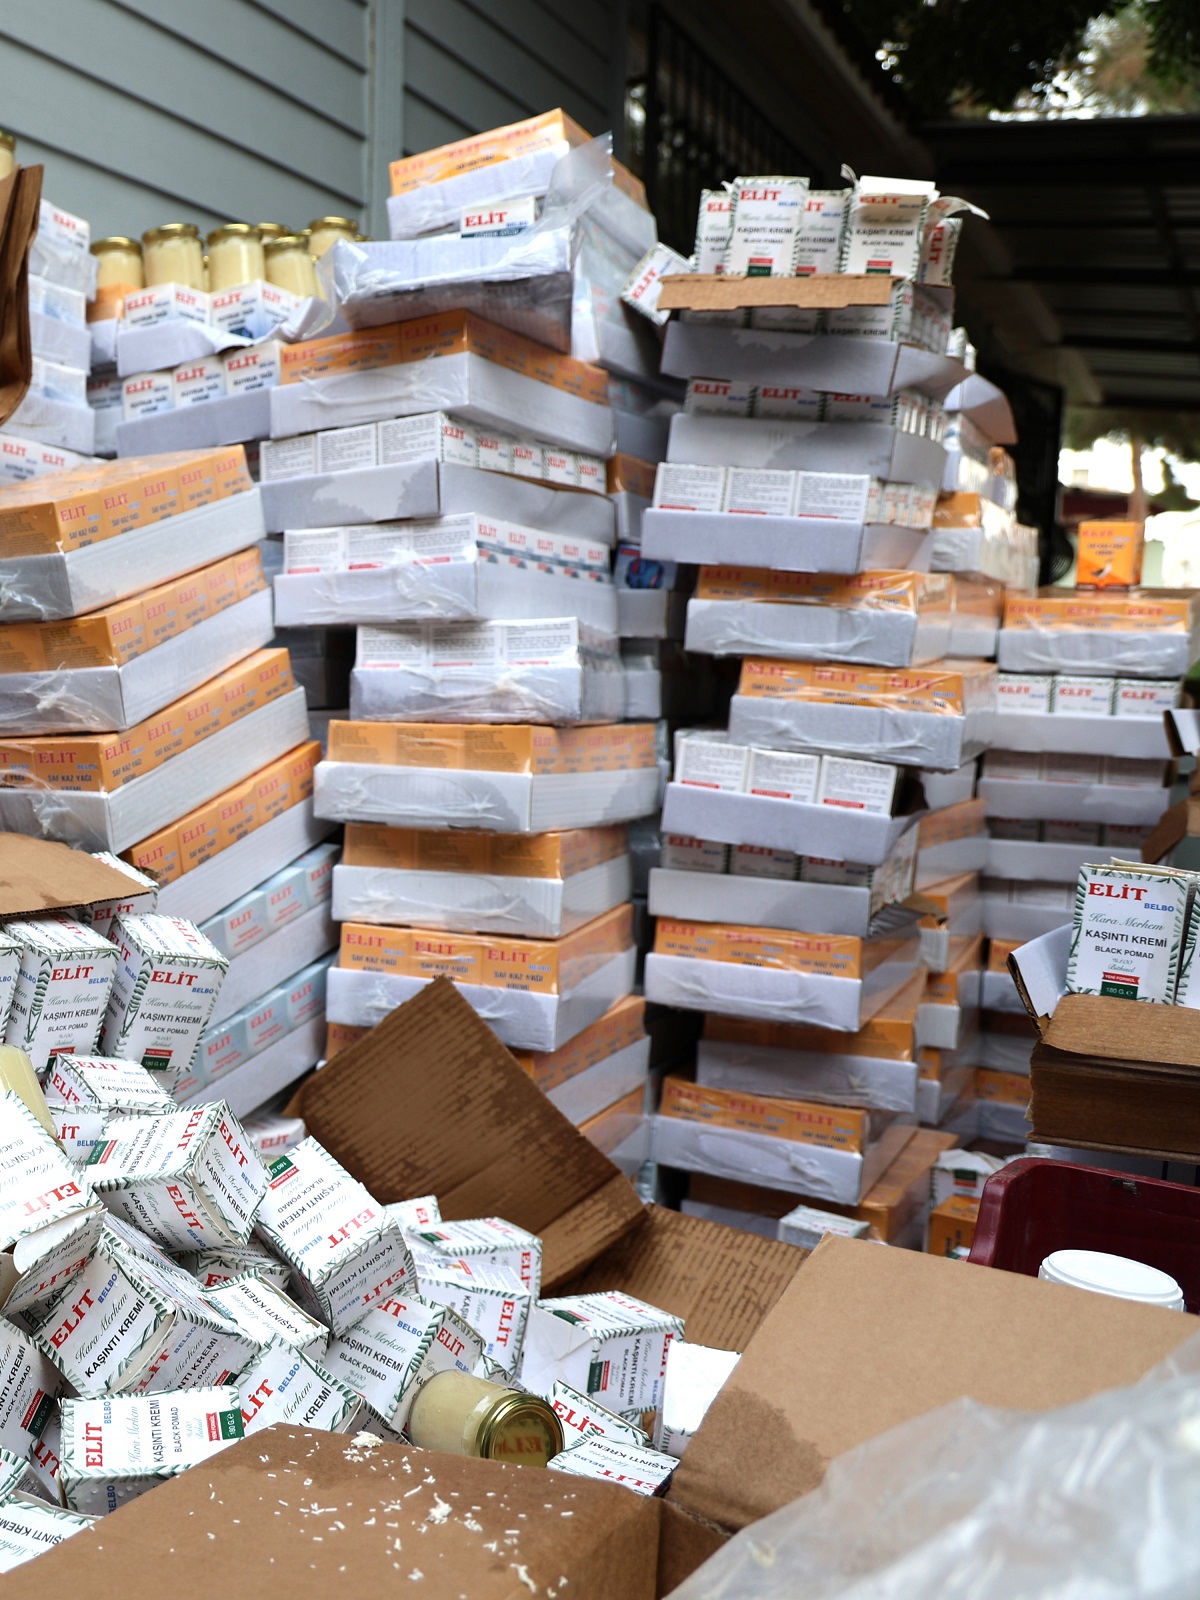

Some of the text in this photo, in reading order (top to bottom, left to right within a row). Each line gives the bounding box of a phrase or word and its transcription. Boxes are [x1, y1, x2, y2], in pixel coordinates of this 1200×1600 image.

[740, 189, 781, 201] ELİT
[464, 210, 508, 228] ELİT
[60, 504, 88, 523] ELİT
[1088, 882, 1174, 912] ELİT BELBO
[1088, 913, 1164, 931] Kara Merhem
[1085, 929, 1168, 948] KAŞINTI KREMİ
[1095, 945, 1154, 959] BLACK POMAD
[151, 970, 214, 995] ELİT BELBO
[139, 1012, 202, 1025] KAŞINTI KREMİ
[50, 1273, 118, 1349] ELİT BELBO
[75, 1293, 129, 1365] Kara Merhem
[85, 1298, 145, 1378] KAŞINTI KREMİ
[437, 1327, 465, 1357] ELİT
[338, 1334, 404, 1373] KAŞINTI KREMİ
[339, 1352, 387, 1381] BLACK POMAD
[85, 1400, 112, 1468] ELİT BELBO
[150, 1400, 165, 1463] KAŞINTI KREMİ
[170, 1407, 183, 1452] BLACK POMAD
